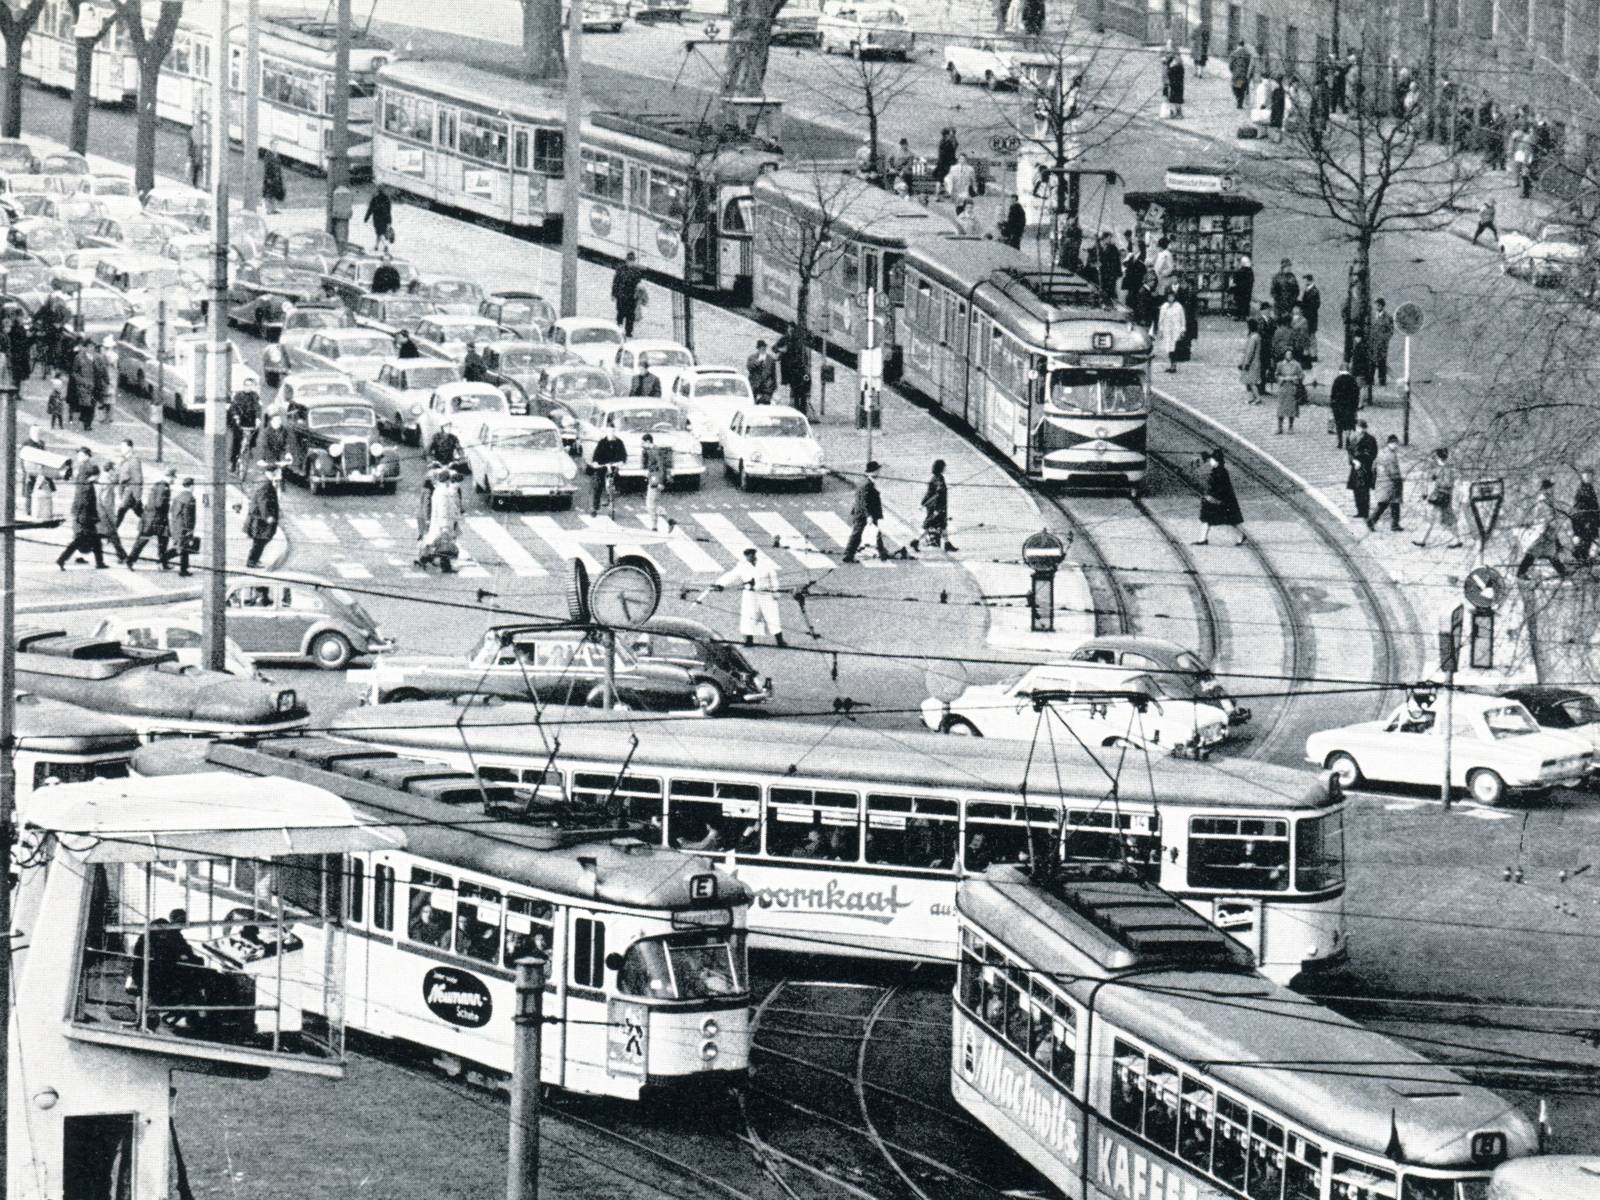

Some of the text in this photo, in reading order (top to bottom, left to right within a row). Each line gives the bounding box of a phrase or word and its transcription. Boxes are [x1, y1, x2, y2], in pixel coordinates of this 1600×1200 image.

[1098, 335, 1107, 346] E
[697, 879, 709, 896] E
[750, 879, 912, 914] oornkaat
